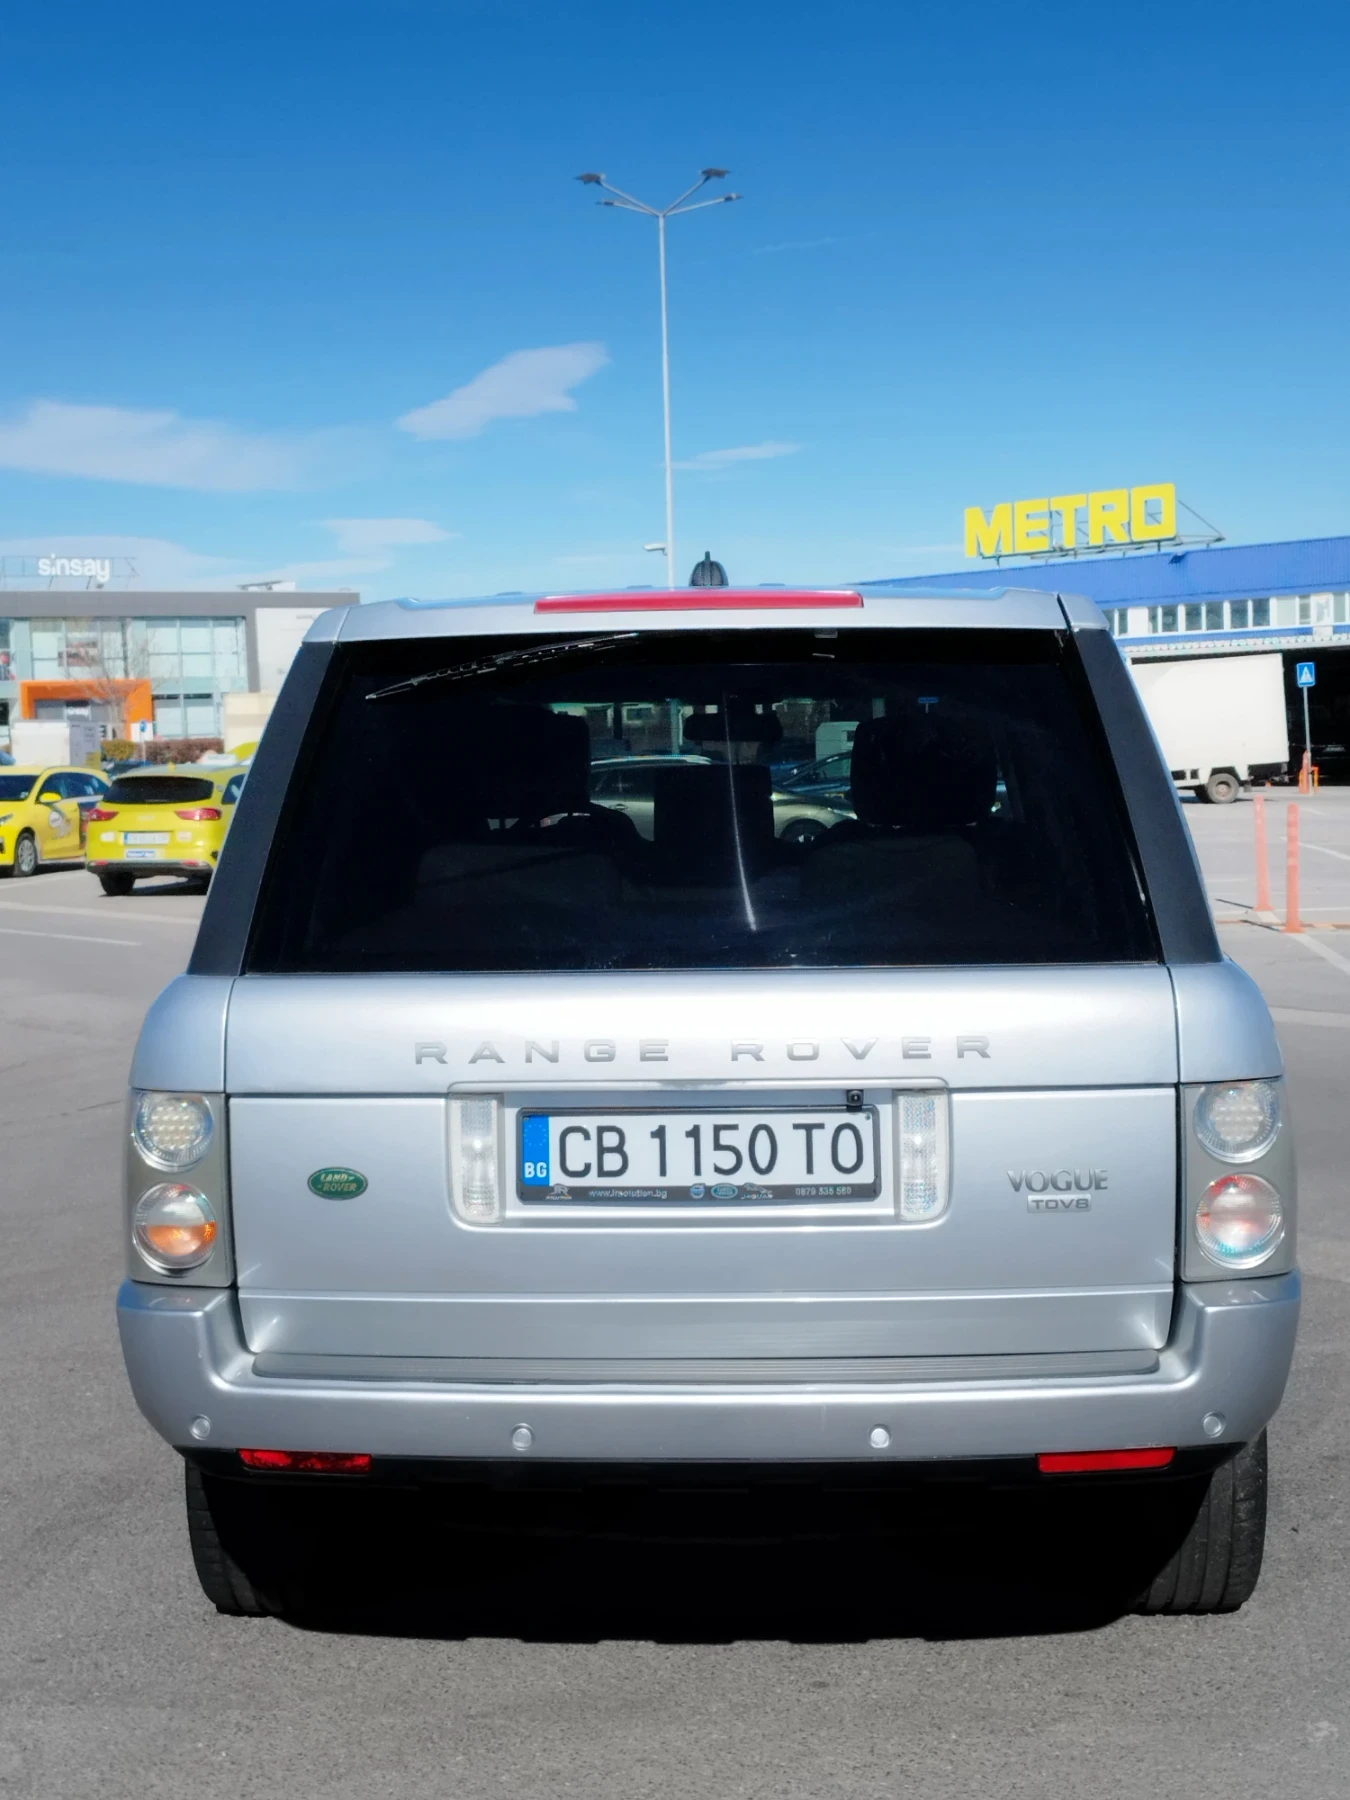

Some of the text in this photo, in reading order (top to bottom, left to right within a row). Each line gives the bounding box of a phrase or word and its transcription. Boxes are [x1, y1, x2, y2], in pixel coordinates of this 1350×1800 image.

[964, 482, 1177, 558] METRO
[38, 554, 110, 582] sinsay
[414, 1035, 992, 1065] RANGE ROVER
[558, 1121, 865, 1179] CB 1150 TO
[320, 1173, 348, 1182] LAND
[524, 1161, 548, 1179] BG
[1007, 1168, 1108, 1193] VOGUE
[323, 1182, 357, 1191] ROVER
